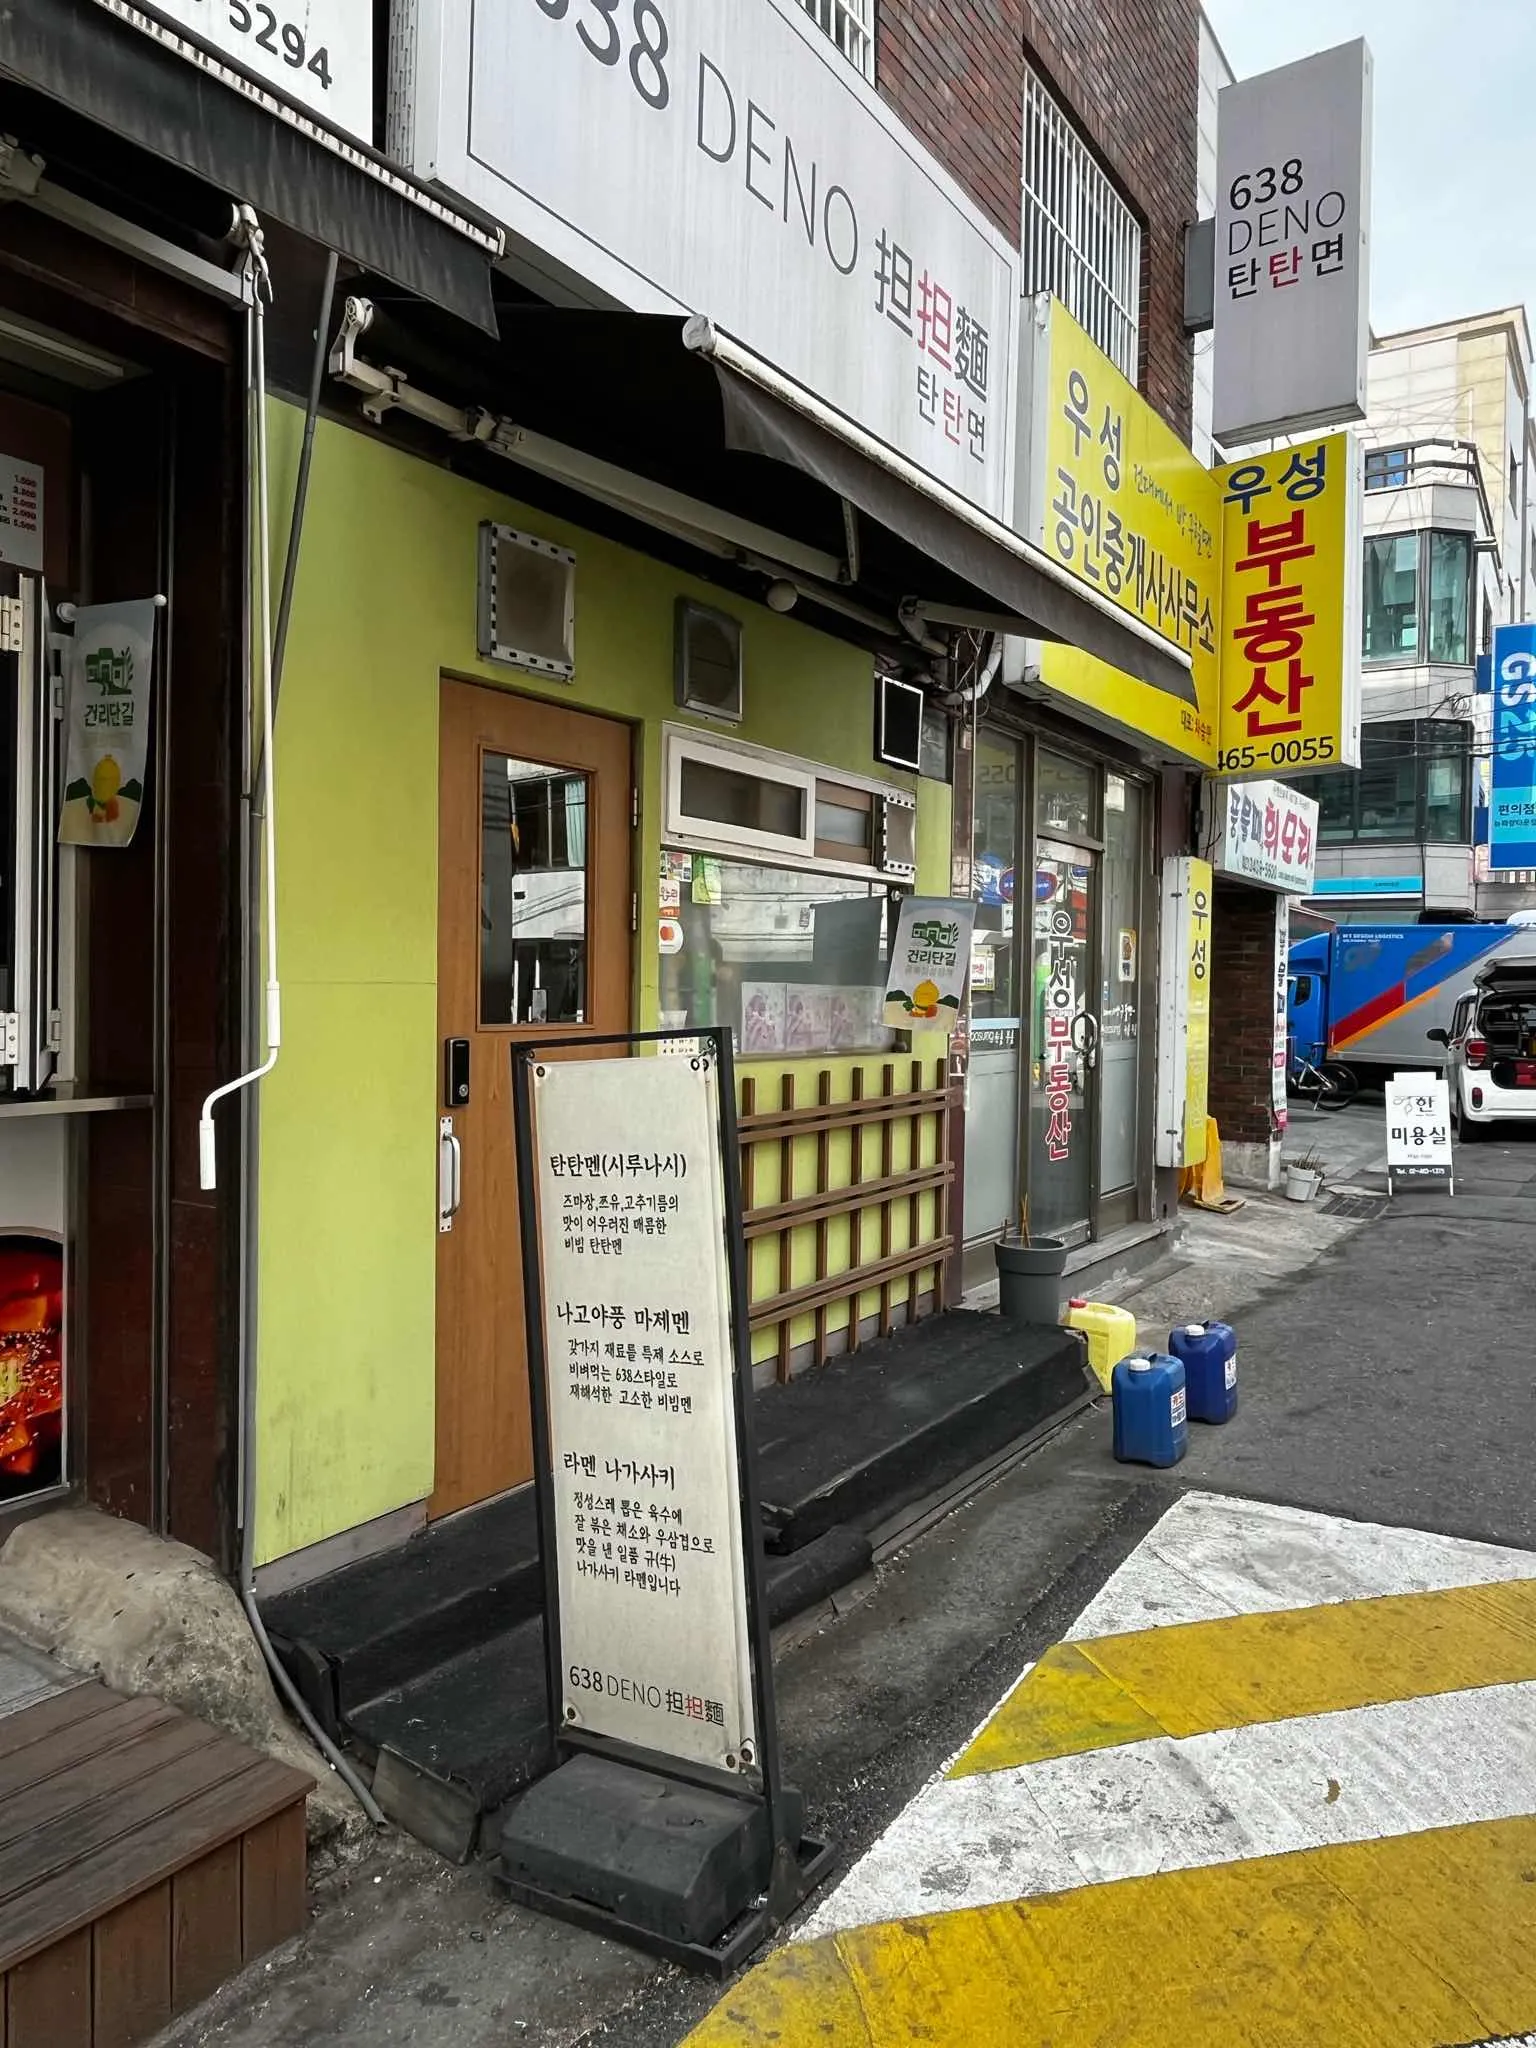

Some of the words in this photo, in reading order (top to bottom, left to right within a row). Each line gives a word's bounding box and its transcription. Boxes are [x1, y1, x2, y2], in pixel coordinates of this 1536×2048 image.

[535, 0, 669, 110] 38
[697, 52, 858, 275] DENO
[874, 228, 988, 403] 担担麵
[1230, 158, 1303, 210] 638
[1229, 191, 1345, 256] DENO
[1229, 232, 1343, 299] 탄탄면
[917, 365, 985, 464] 탄탄면
[1064, 370, 1121, 491] 우성
[1224, 444, 1326, 515] 우성
[1053, 468, 1214, 654] 공인중개사사무소
[1232, 508, 1316, 737] 부동산
[84, 701, 134, 727] 건리단길
[1498, 803, 1536, 816] 편의점
[1264, 797, 1311, 869] 휘모리
[1192, 891, 1208, 980] 우성
[907, 949, 957, 967] 건리단길
[1049, 910, 1074, 1009] 우성
[1045, 1016, 1073, 1161] 부동산
[1391, 1126, 1446, 1146] 미용실
[550, 1153, 687, 1177] 탄탄멘(시루나시)
[563, 1216, 583, 1232] 맛이
[587, 1216, 629, 1234] 어우러진
[634, 1217, 667, 1234] 매콤한
[565, 1236, 584, 1254] 비빔
[590, 1237, 622, 1255] 탄탄멘
[557, 1302, 626, 1330] 나고야풍
[634, 1307, 690, 1335] 마제멘
[605, 1342, 637, 1362] 재료를
[642, 1345, 664, 1364] 특제
[669, 1349, 704, 1366] 소스로
[569, 1361, 611, 1382] 비벼먹는
[616, 1368, 678, 1389] 638스타일로
[570, 1383, 612, 1404] 재해석한
[619, 1390, 652, 1409] 고소한
[658, 1394, 692, 1414] 비빔멘
[564, 1452, 596, 1477] 라멘
[605, 1458, 675, 1490] 나가사키
[574, 1492, 615, 1514] 정성스레
[648, 1503, 682, 1526] 육수에
[574, 1514, 585, 1532] 잘
[591, 1516, 611, 1536] 볶은
[616, 1522, 650, 1543] 채소와
[656, 1528, 715, 1553] 우삼겹으로
[576, 1537, 597, 1556] 맛을
[602, 1542, 612, 1560] 낸
[617, 1545, 639, 1564] 일품
[577, 1559, 619, 1584] 나가사키
[624, 1569, 681, 1597] 라멘입니다
[570, 1665, 603, 1692] 638
[607, 1675, 661, 1708] DENO
[665, 1688, 725, 1727] 担担麵
